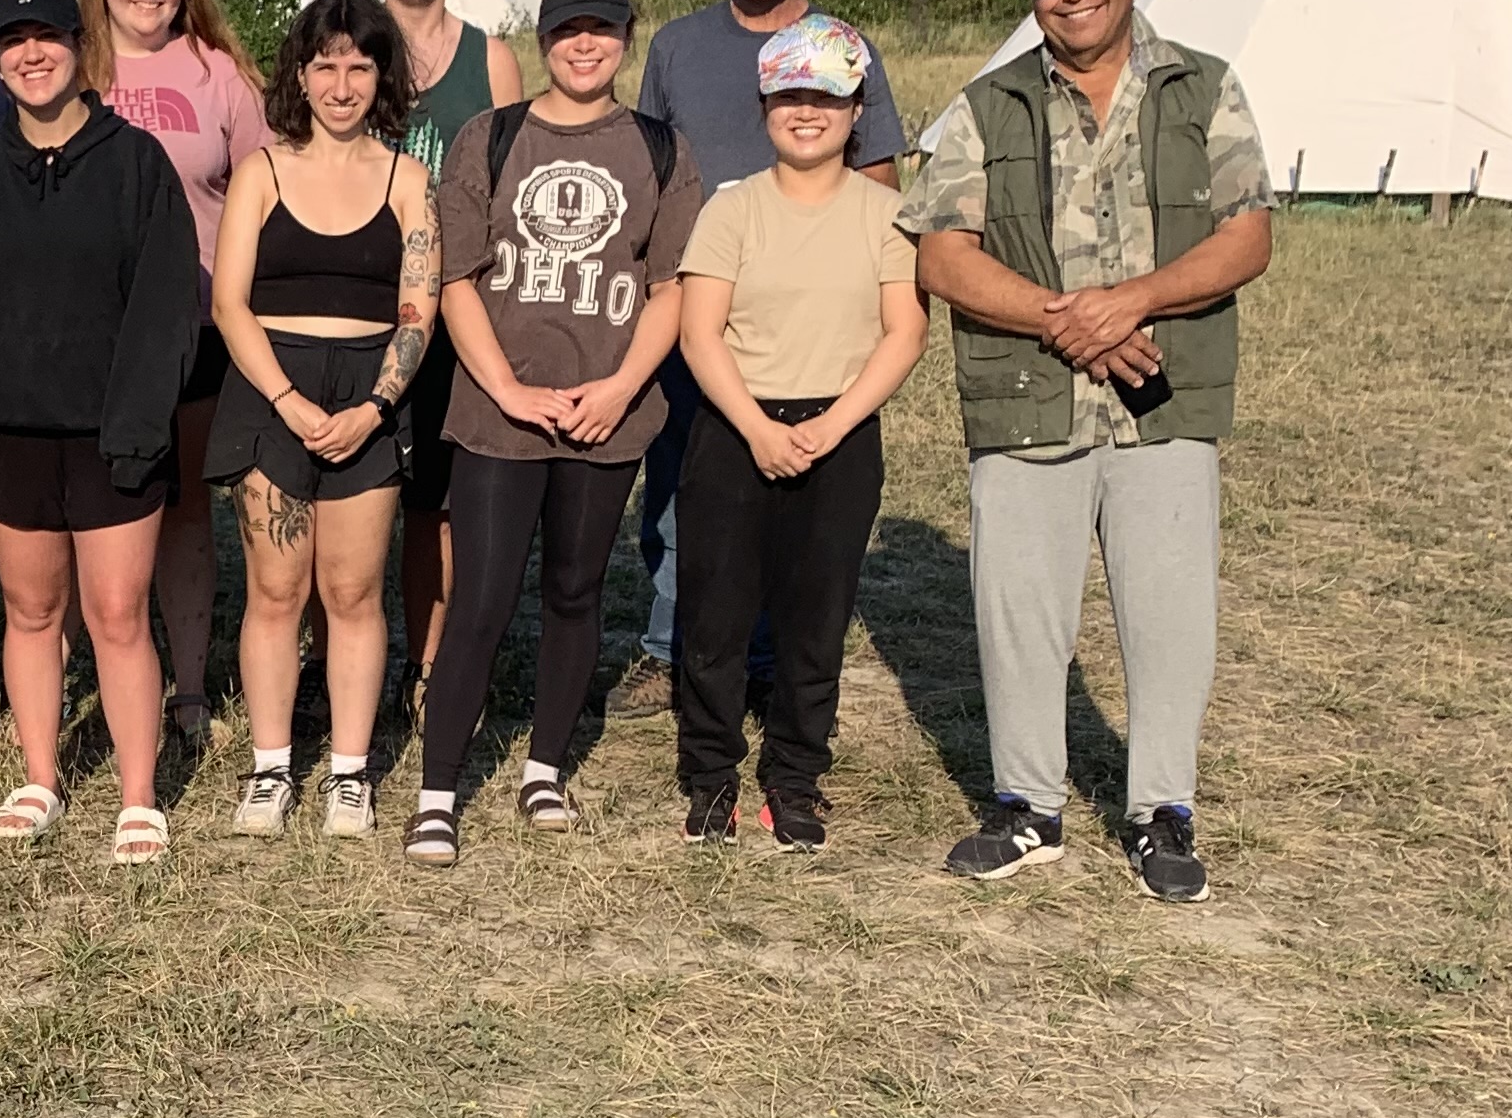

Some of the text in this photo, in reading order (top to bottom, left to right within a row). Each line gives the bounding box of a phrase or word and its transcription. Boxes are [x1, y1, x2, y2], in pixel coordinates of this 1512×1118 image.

[111, 88, 154, 103] THE
[522, 172, 551, 208] COLUMBUS
[549, 168, 582, 179] SPORTS
[582, 169, 617, 209] DEPARTMENT
[558, 207, 581, 218] USA
[543, 238, 593, 251] CHAMPION
